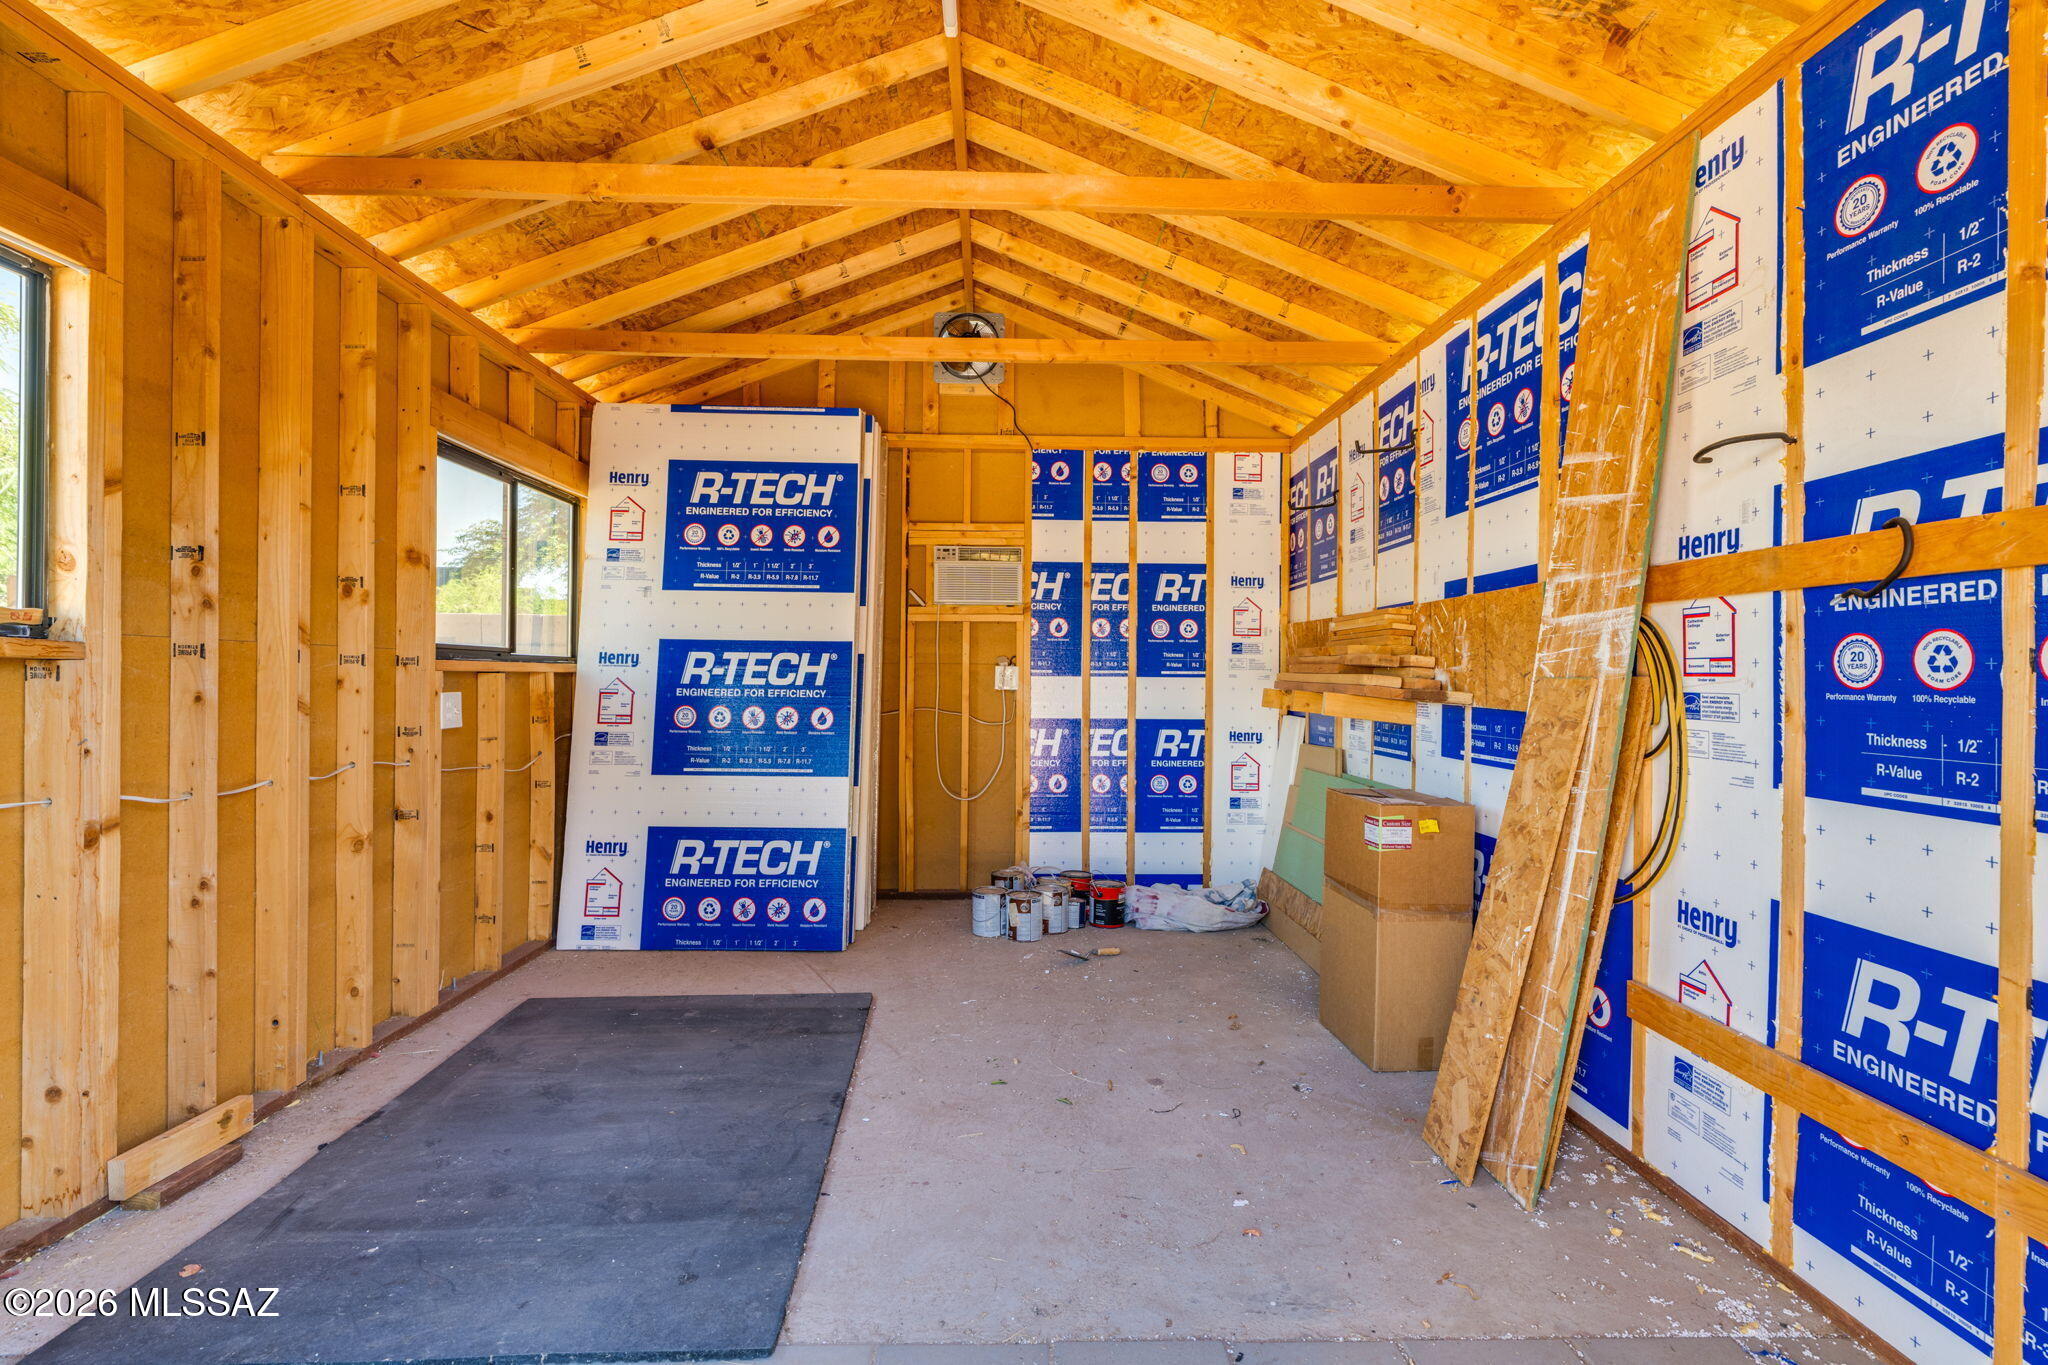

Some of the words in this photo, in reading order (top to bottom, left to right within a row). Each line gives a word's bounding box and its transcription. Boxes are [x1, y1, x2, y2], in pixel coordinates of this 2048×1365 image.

[1837, 50, 2002, 168] ENGINEERED
[1852, 194, 1867, 210] 20
[1914, 201, 1934, 216] 100%
[1936, 179, 1980, 206] Recyclable
[1849, 204, 1870, 219] YEARS
[1826, 236, 1866, 261] Performance
[1868, 220, 1898, 240] Warranty
[1866, 248, 1928, 283] Thickness
[1876, 280, 1924, 308] R-Value
[1958, 253, 1981, 274] R-2
[1514, 360, 1532, 380] FOR
[610, 471, 649, 487] Henry
[686, 507, 749, 516] ENGINEERED
[752, 508, 773, 516] FOR
[775, 508, 833, 518] EFFICIENCY
[1679, 528, 1740, 560] Henry
[1230, 576, 1264, 588] Henry
[1834, 579, 1998, 612] ENGINEERED
[1932, 636, 1963, 649] RECYCLABLE
[598, 652, 640, 668] Henry
[1850, 652, 1864, 662] 20
[1927, 674, 1944, 683] FOAM
[1946, 672, 1962, 682] CORE
[676, 688, 741, 698] ENGINEERED
[744, 688, 764, 698] FOR
[768, 688, 826, 698] EFFICIENCY
[1826, 692, 1865, 700] Performance
[1866, 694, 1896, 703] Warranty
[1912, 694, 1932, 703] 100%
[1934, 696, 1976, 704] Recyclable
[1229, 731, 1262, 744] Henry
[1866, 732, 1927, 750] Thickness
[1876, 764, 1922, 780] R-Value
[1956, 771, 1980, 787] R-2
[586, 840, 628, 856] Henry
[665, 878, 732, 888] ENGINEERED
[734, 878, 756, 888] FOR
[759, 878, 819, 888] EFFICIENCY
[1678, 899, 1737, 948] Henry
[1842, 957, 1998, 1085] R-T
[1833, 1040, 1996, 1128] ENGINEERED
[1820, 1133, 1859, 1161] Performance
[1860, 1155, 1890, 1180] Warranty
[1906, 1181, 1925, 1198] 100%
[1926, 1192, 1969, 1222] Recyclable
[1858, 1194, 1918, 1240] Thickness
[1866, 1229, 1912, 1268] R-Value
[1945, 1280, 1968, 1306] R-2
